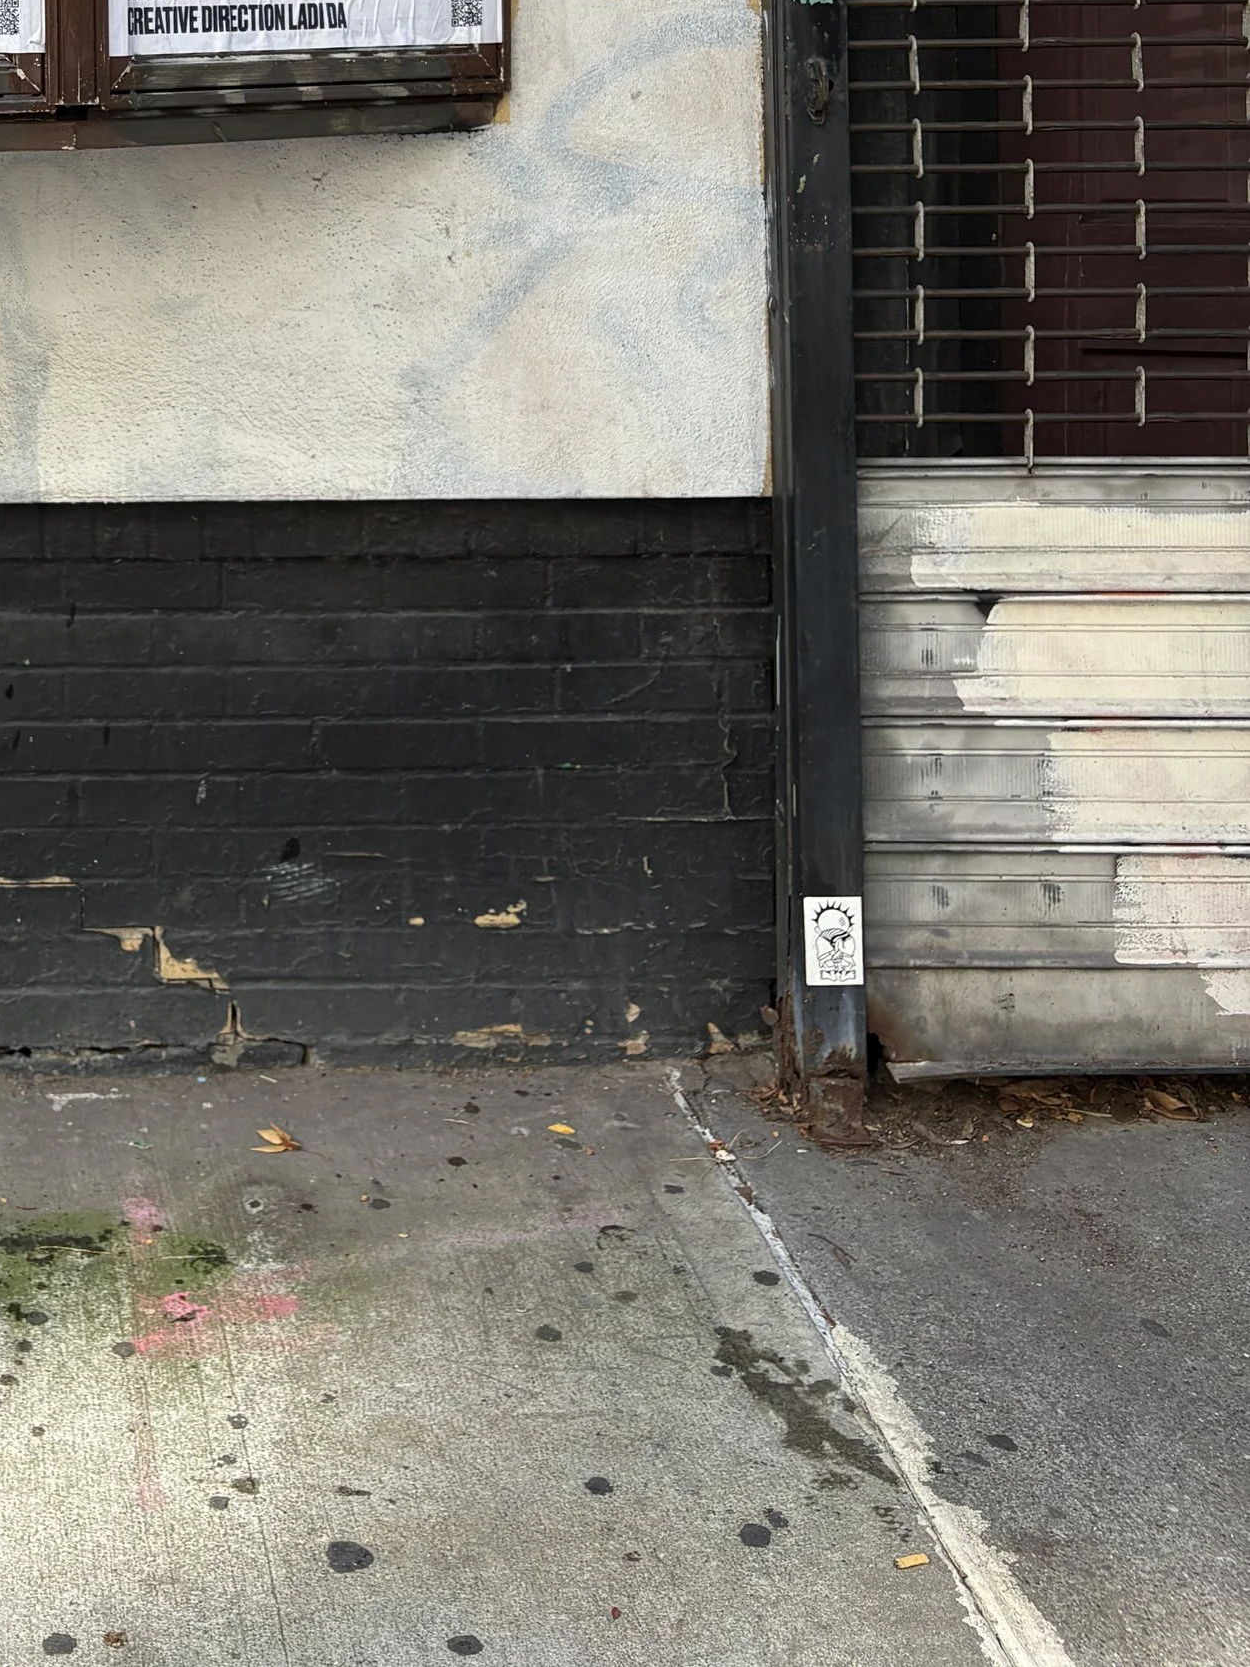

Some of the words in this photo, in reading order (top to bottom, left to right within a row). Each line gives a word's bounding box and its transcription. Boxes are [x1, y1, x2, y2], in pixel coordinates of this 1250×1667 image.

[128, 5, 198, 35] CREATIVE
[202, 3, 286, 32] DIRECTION
[289, 3, 325, 30] LADI
[327, 2, 347, 29] DA
